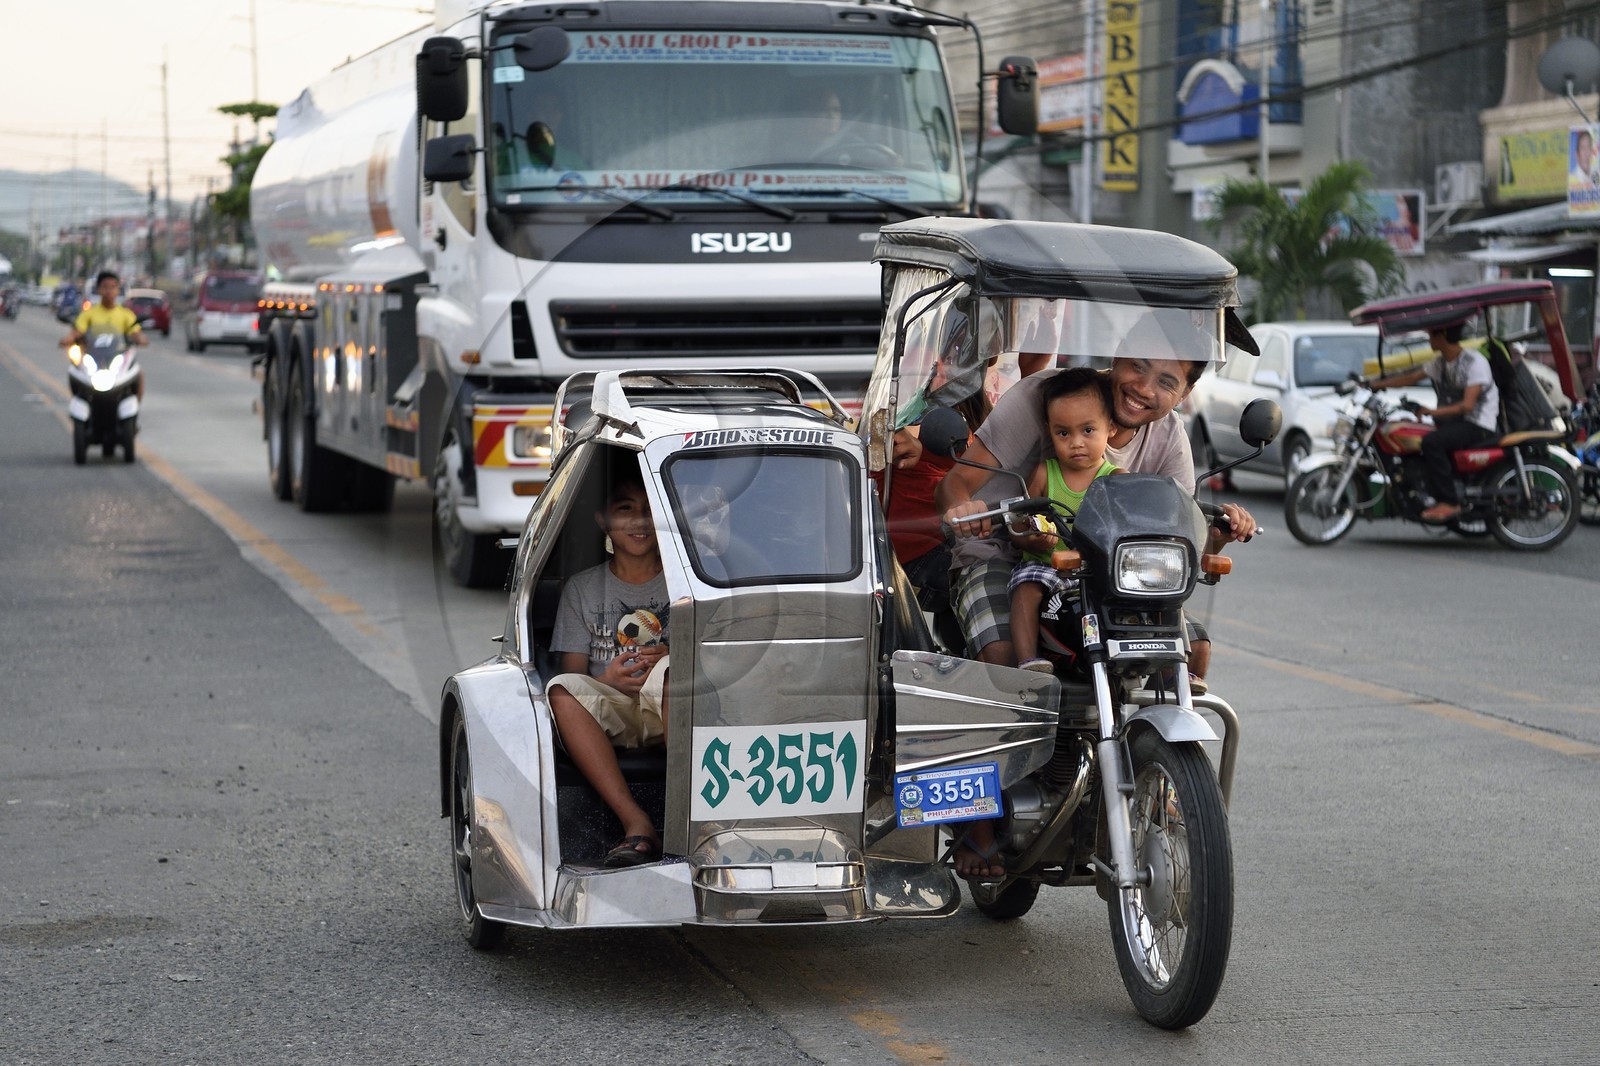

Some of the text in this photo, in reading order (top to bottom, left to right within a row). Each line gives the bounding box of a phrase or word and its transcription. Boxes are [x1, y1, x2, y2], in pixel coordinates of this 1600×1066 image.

[580, 34, 742, 49] ASAHI GROUP
[1108, 34, 1134, 165] BANK
[600, 172, 758, 188] ASAHI GROUP
[691, 232, 792, 253] ISUZU
[1041, 612, 1059, 621] HONDA
[700, 731, 858, 809] S-3551
[928, 776, 985, 804] 3551
[927, 809, 953, 818] PHILIP
